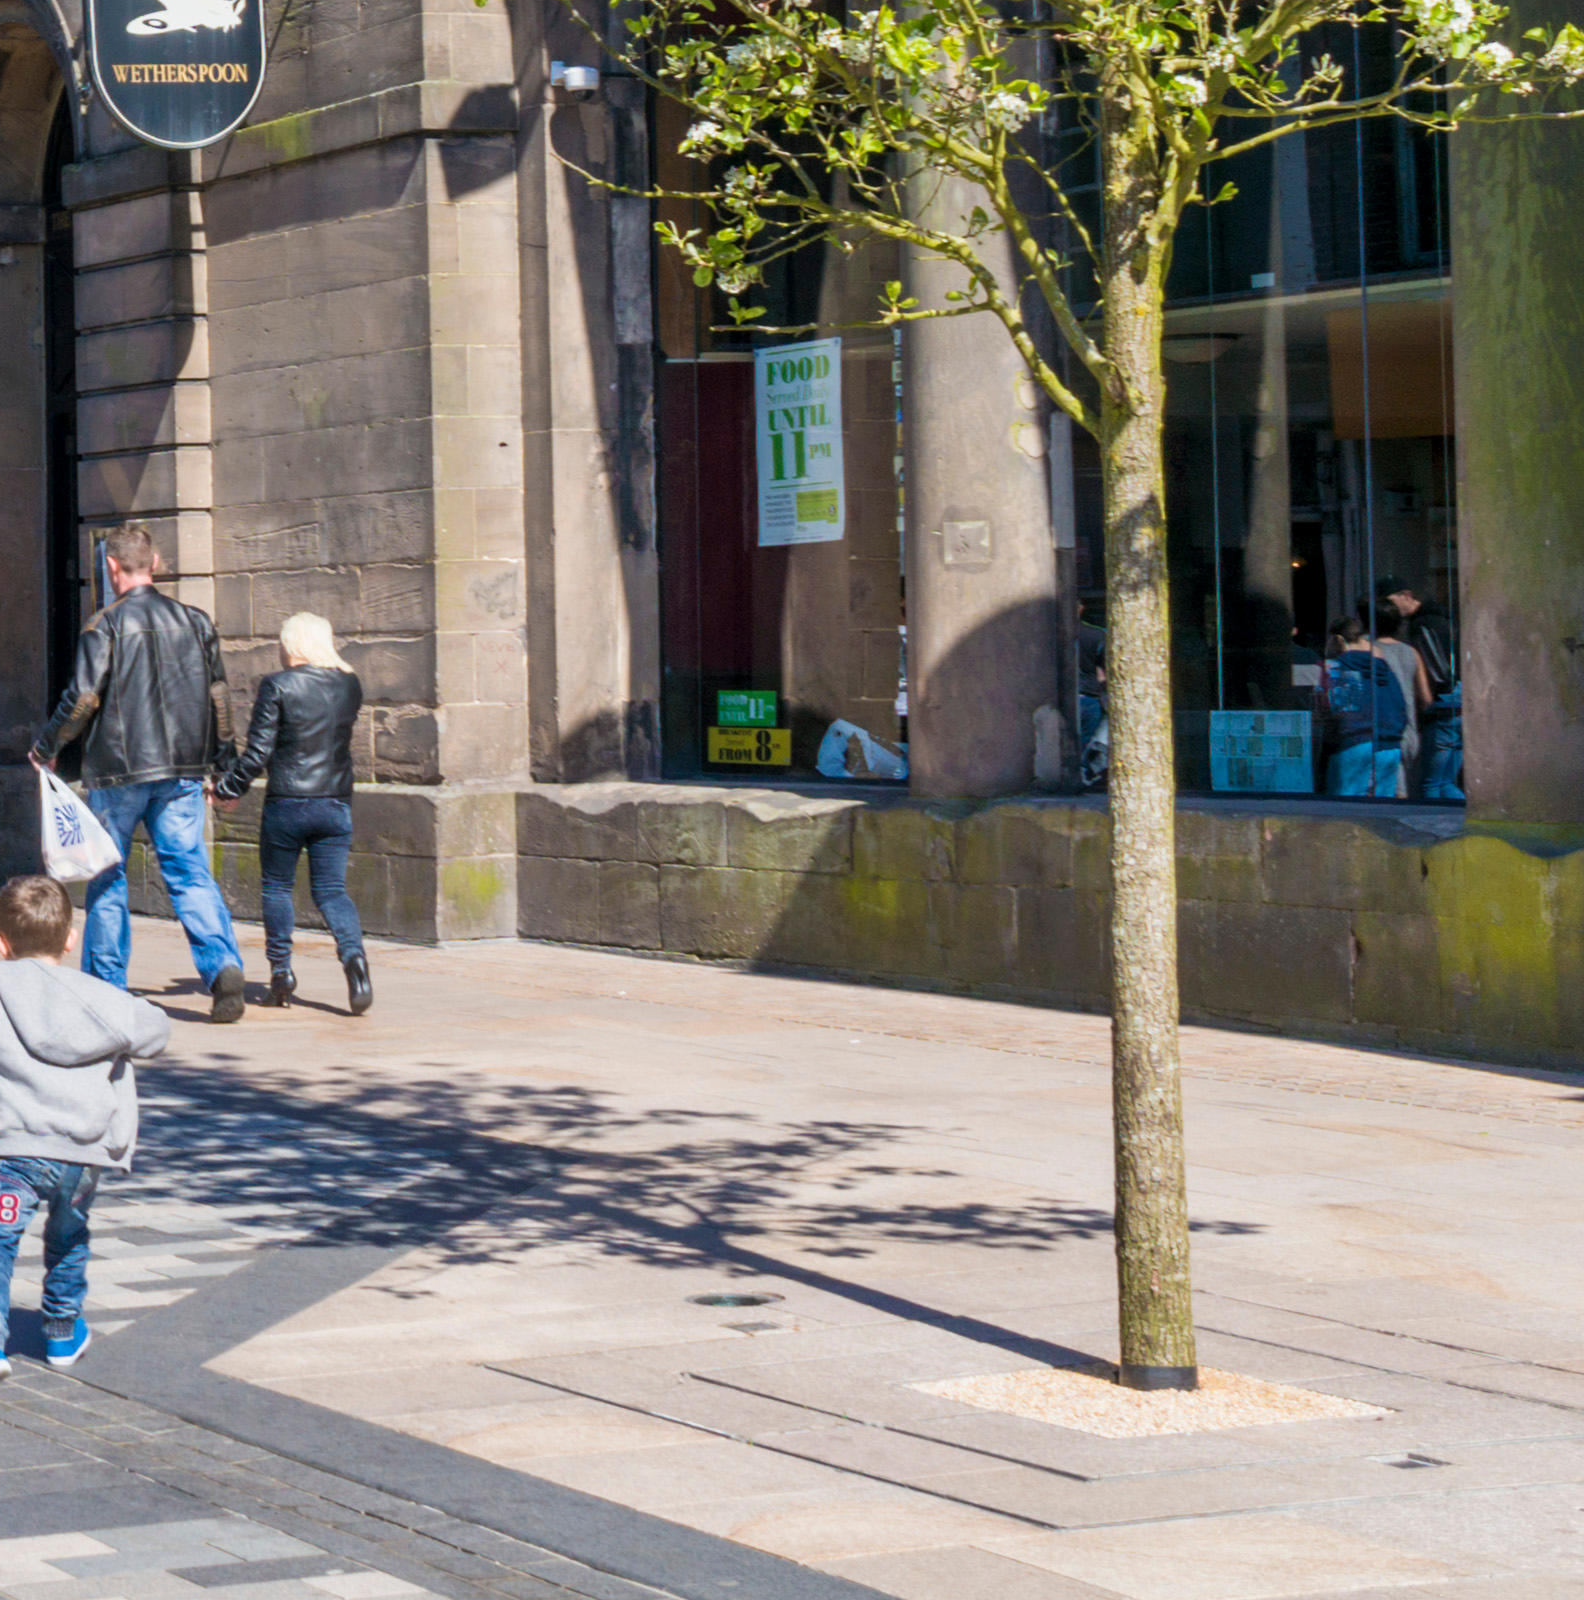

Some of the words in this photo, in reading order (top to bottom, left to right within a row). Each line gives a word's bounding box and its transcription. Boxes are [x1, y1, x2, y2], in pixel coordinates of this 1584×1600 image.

[112, 63, 249, 83] WETHERSPOON
[765, 354, 831, 387] FOOD
[767, 403, 832, 432] UNTIL
[718, 747, 753, 761] FROM
[755, 729, 772, 762] 8
